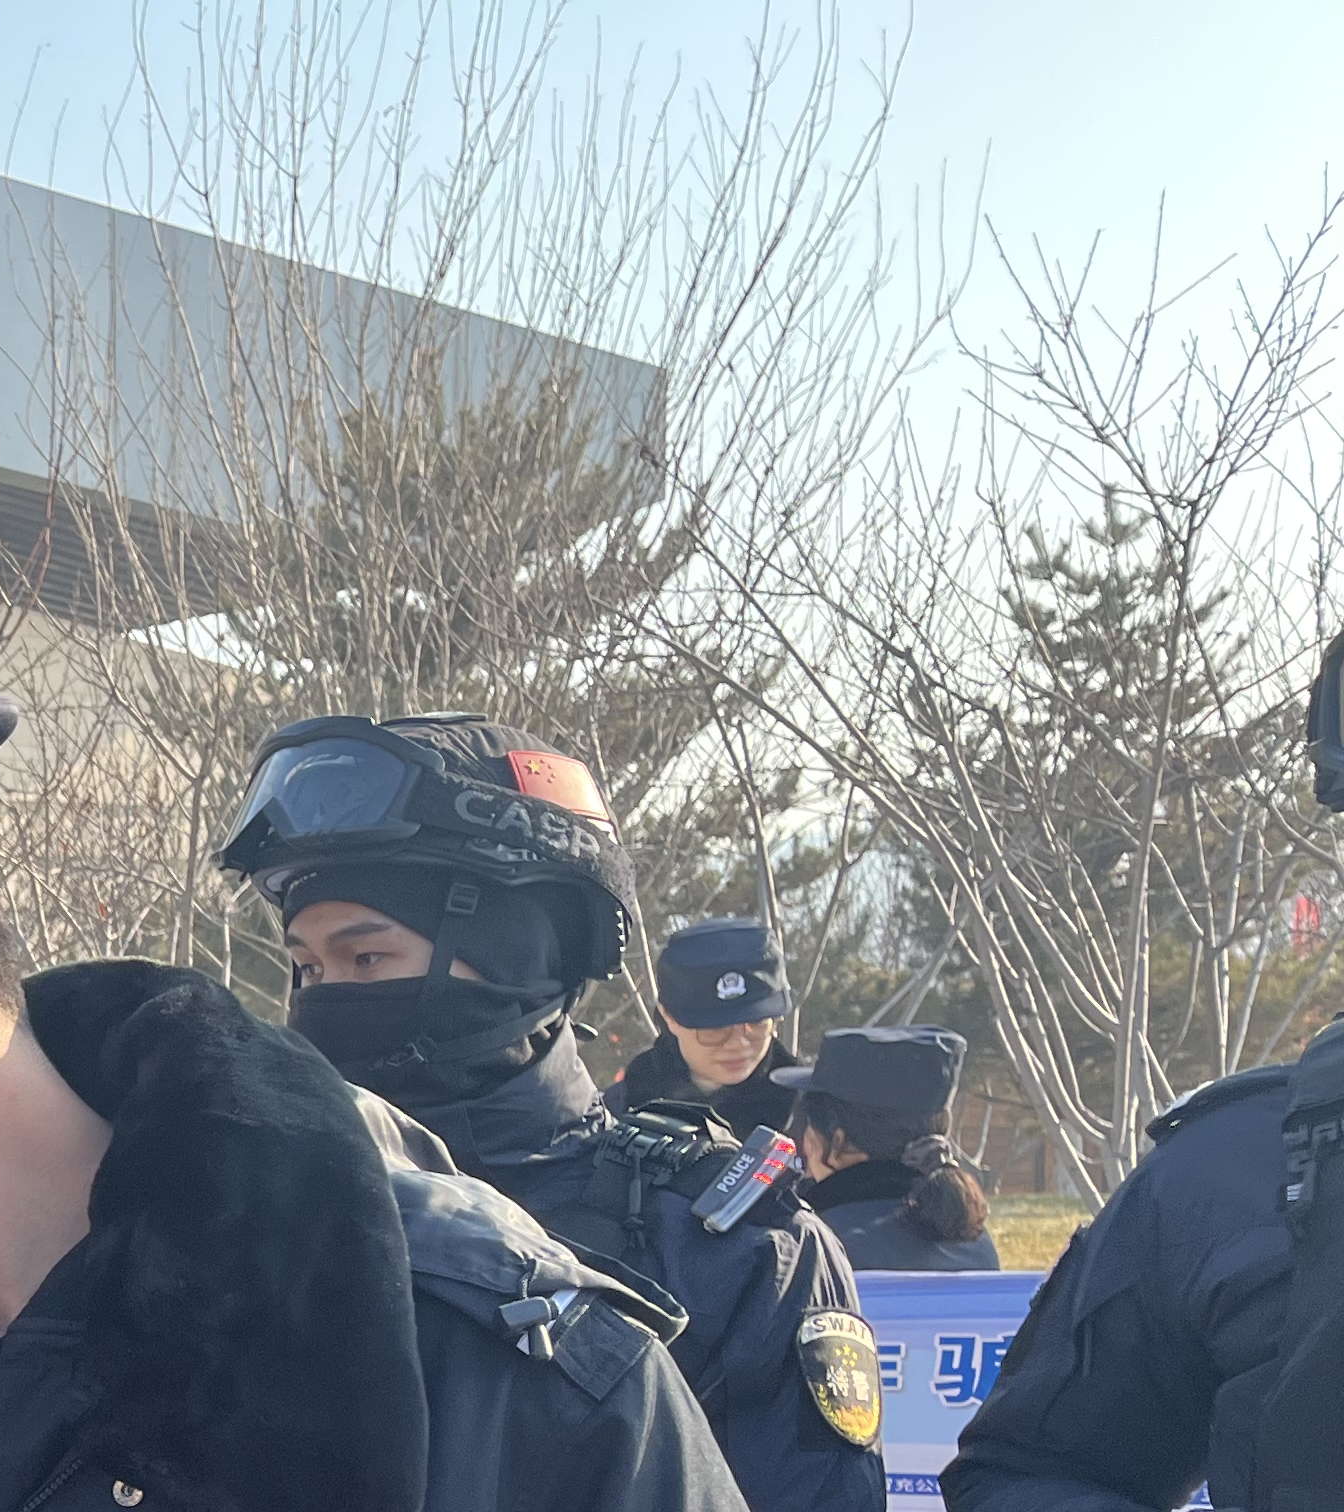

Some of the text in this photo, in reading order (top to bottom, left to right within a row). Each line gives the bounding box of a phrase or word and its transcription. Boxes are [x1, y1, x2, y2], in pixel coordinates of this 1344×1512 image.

[454, 789, 601, 858] CASP
[717, 1153, 756, 1193] POLICE
[813, 1317, 869, 1341] SWAT
[887, 1478, 942, 1494] 充公
